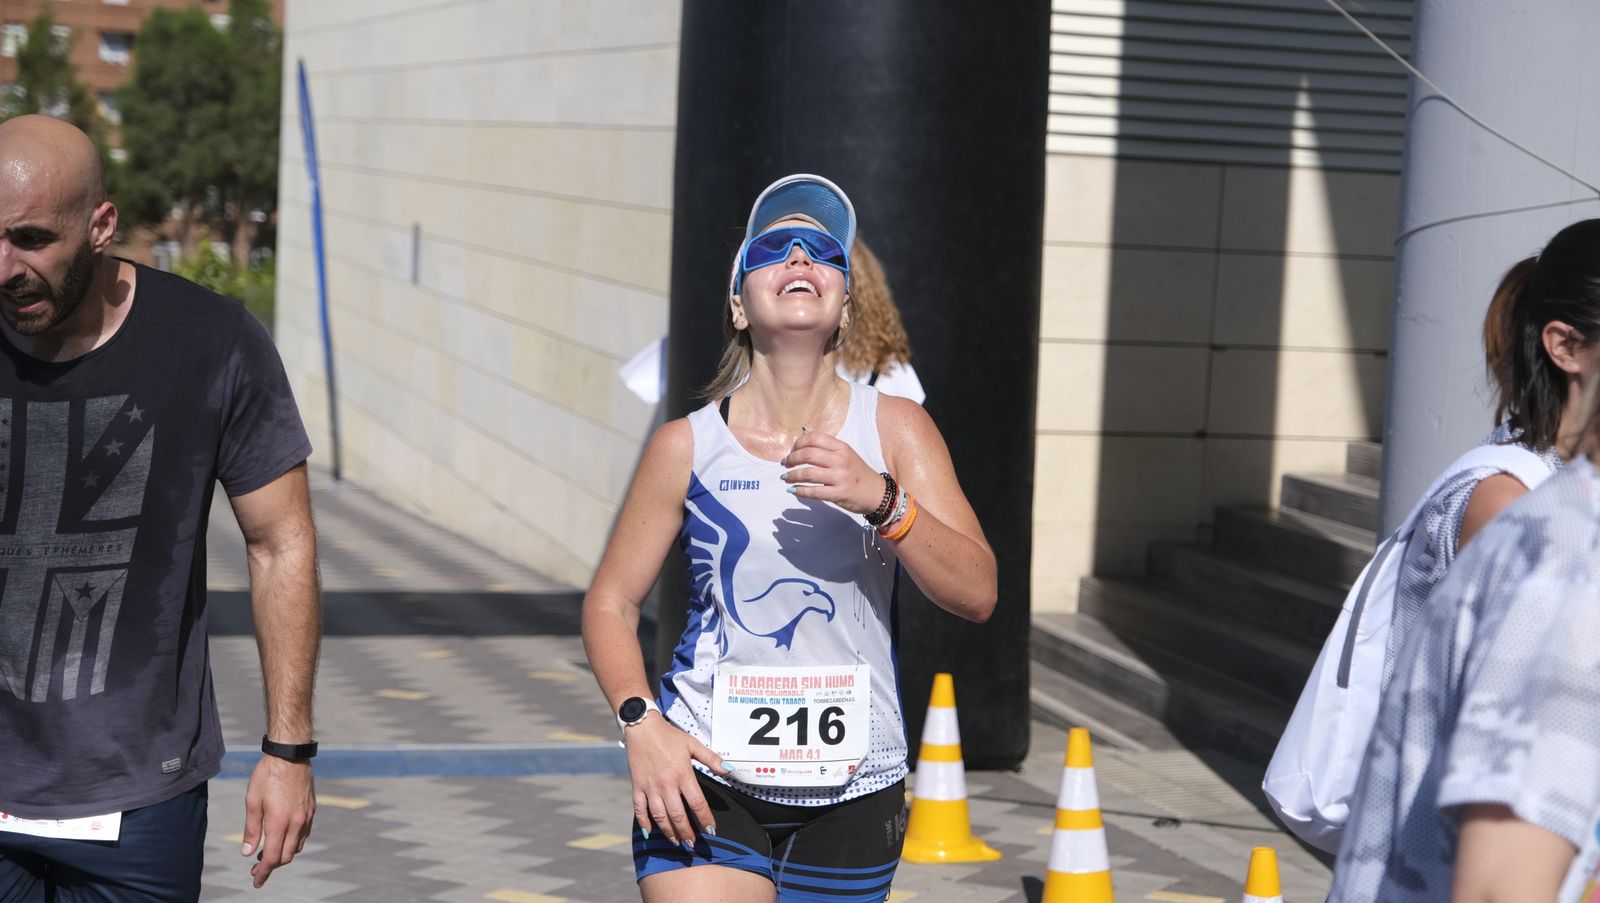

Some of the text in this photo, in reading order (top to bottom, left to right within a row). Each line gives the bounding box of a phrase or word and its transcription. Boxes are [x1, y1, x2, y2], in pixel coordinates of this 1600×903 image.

[729, 674, 854, 689] II CARRERA SIN HUMO
[740, 696, 768, 704] MUNDIAL
[769, 697, 781, 705] SIN
[782, 697, 806, 705] TABACO
[748, 706, 846, 746] 216
[780, 748, 821, 760] MAR 4.1
